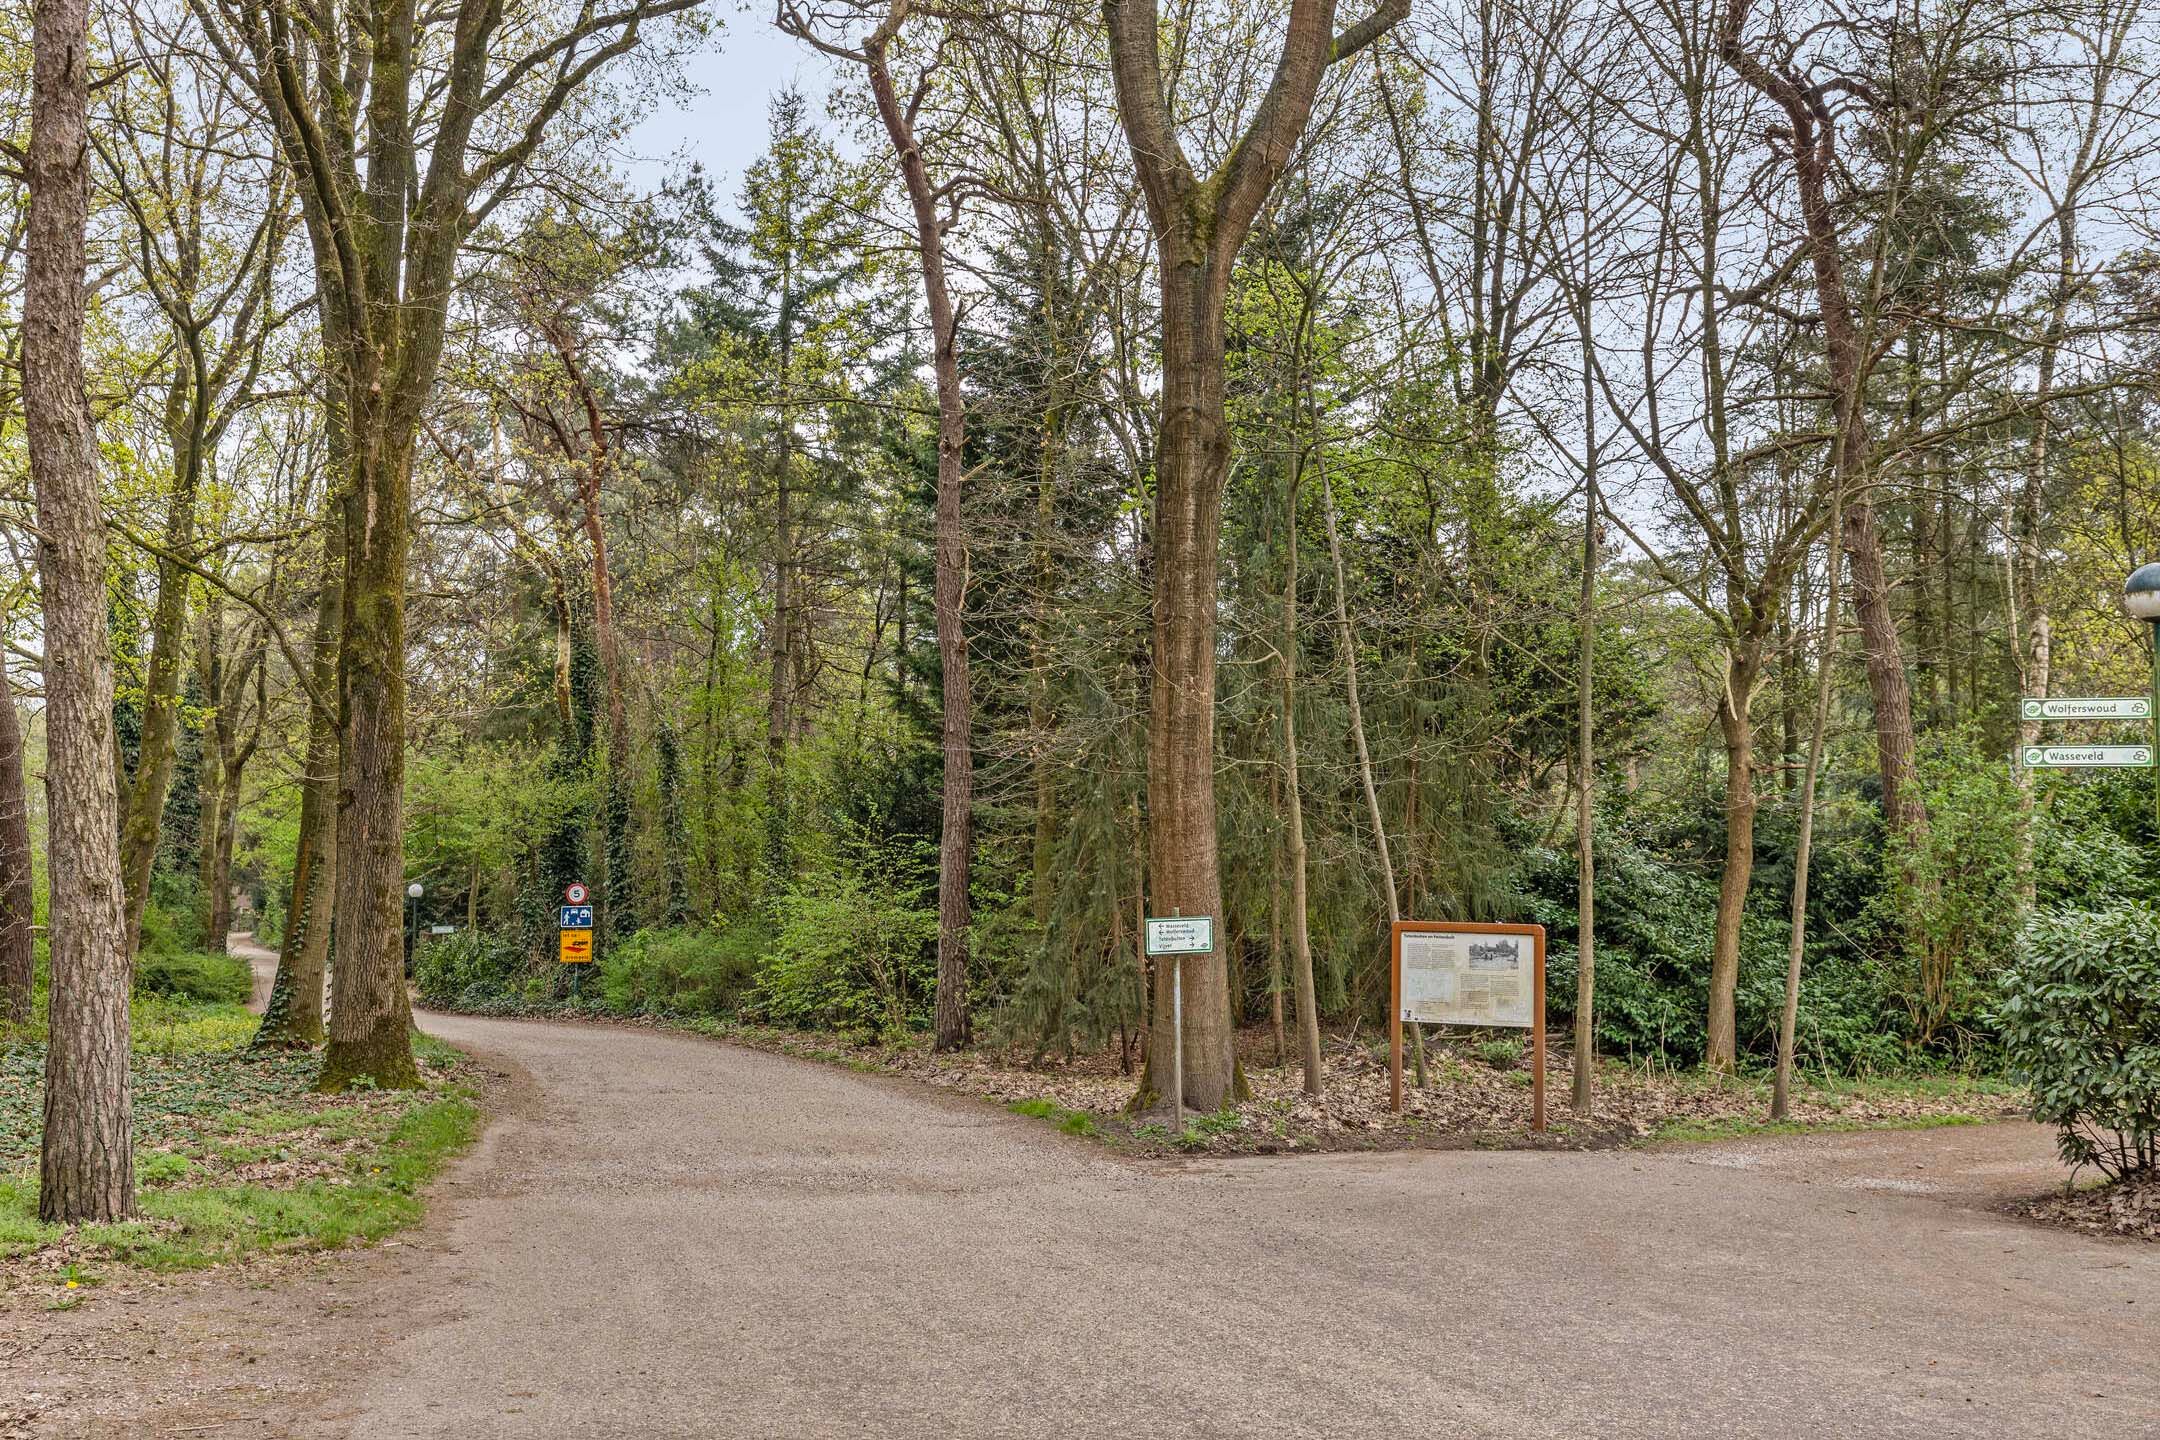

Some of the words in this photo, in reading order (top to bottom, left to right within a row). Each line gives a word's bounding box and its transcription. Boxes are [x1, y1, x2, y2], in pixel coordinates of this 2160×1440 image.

[2048, 704, 2117, 715] Wolferswoud
[2049, 751, 2104, 761] Wasseveld
[573, 890, 581, 898] 5
